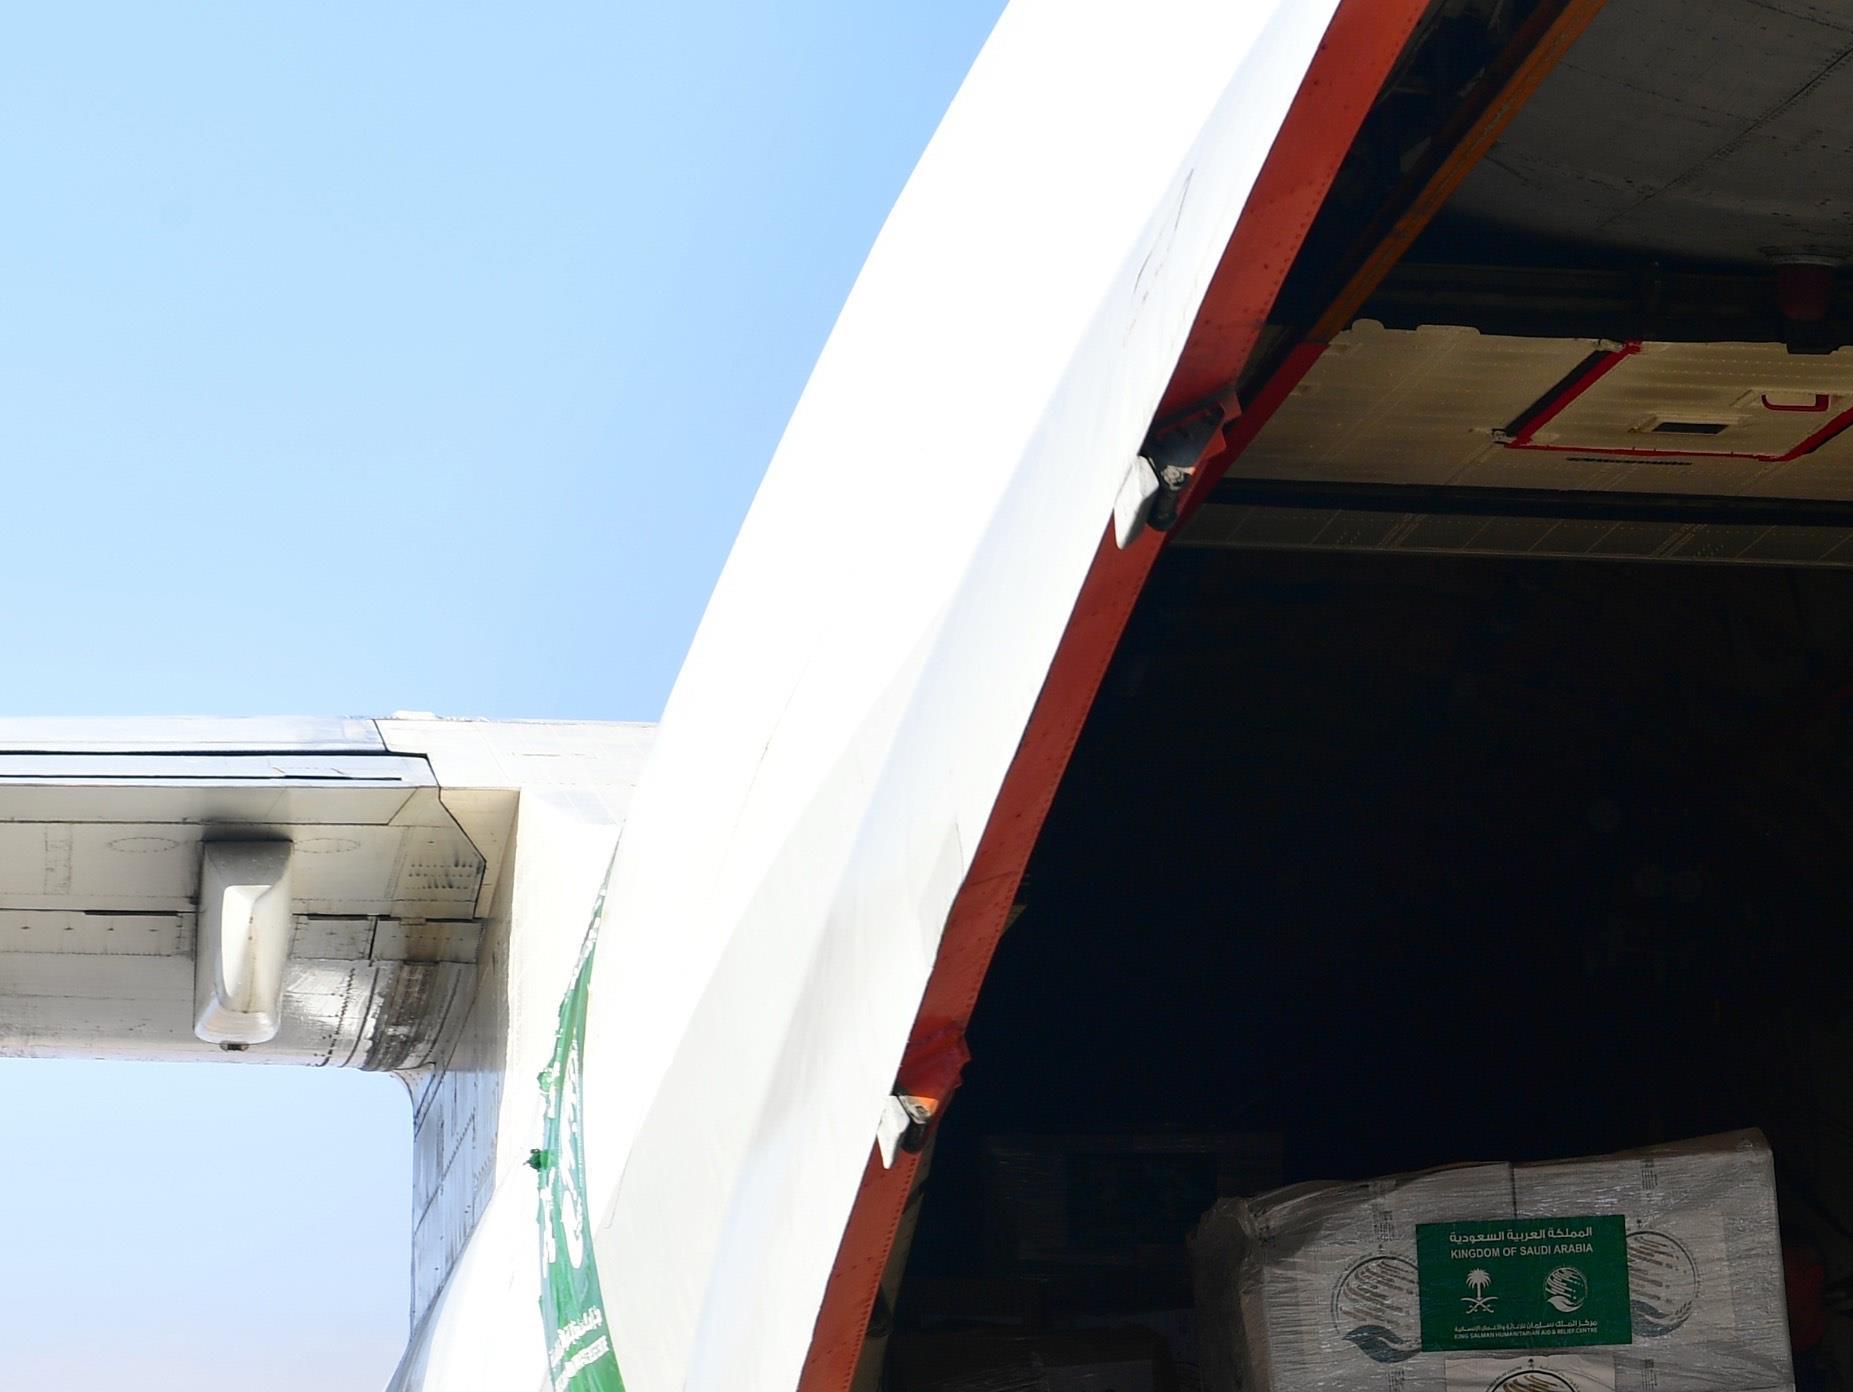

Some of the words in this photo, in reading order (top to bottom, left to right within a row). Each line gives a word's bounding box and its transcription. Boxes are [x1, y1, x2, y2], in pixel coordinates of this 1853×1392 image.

[1449, 1231, 1505, 1244] السعودية
[1506, 1229, 1546, 1242] العربية
[1547, 1226, 1593, 1238] المملكة
[1450, 1248, 1500, 1259] KINGDOM
[1503, 1246, 1517, 1257] OF
[1520, 1245, 1551, 1256] SAUDI
[1553, 1243, 1593, 1254] ARABIA
[1495, 1329, 1540, 1337] HUMANITARIAN
